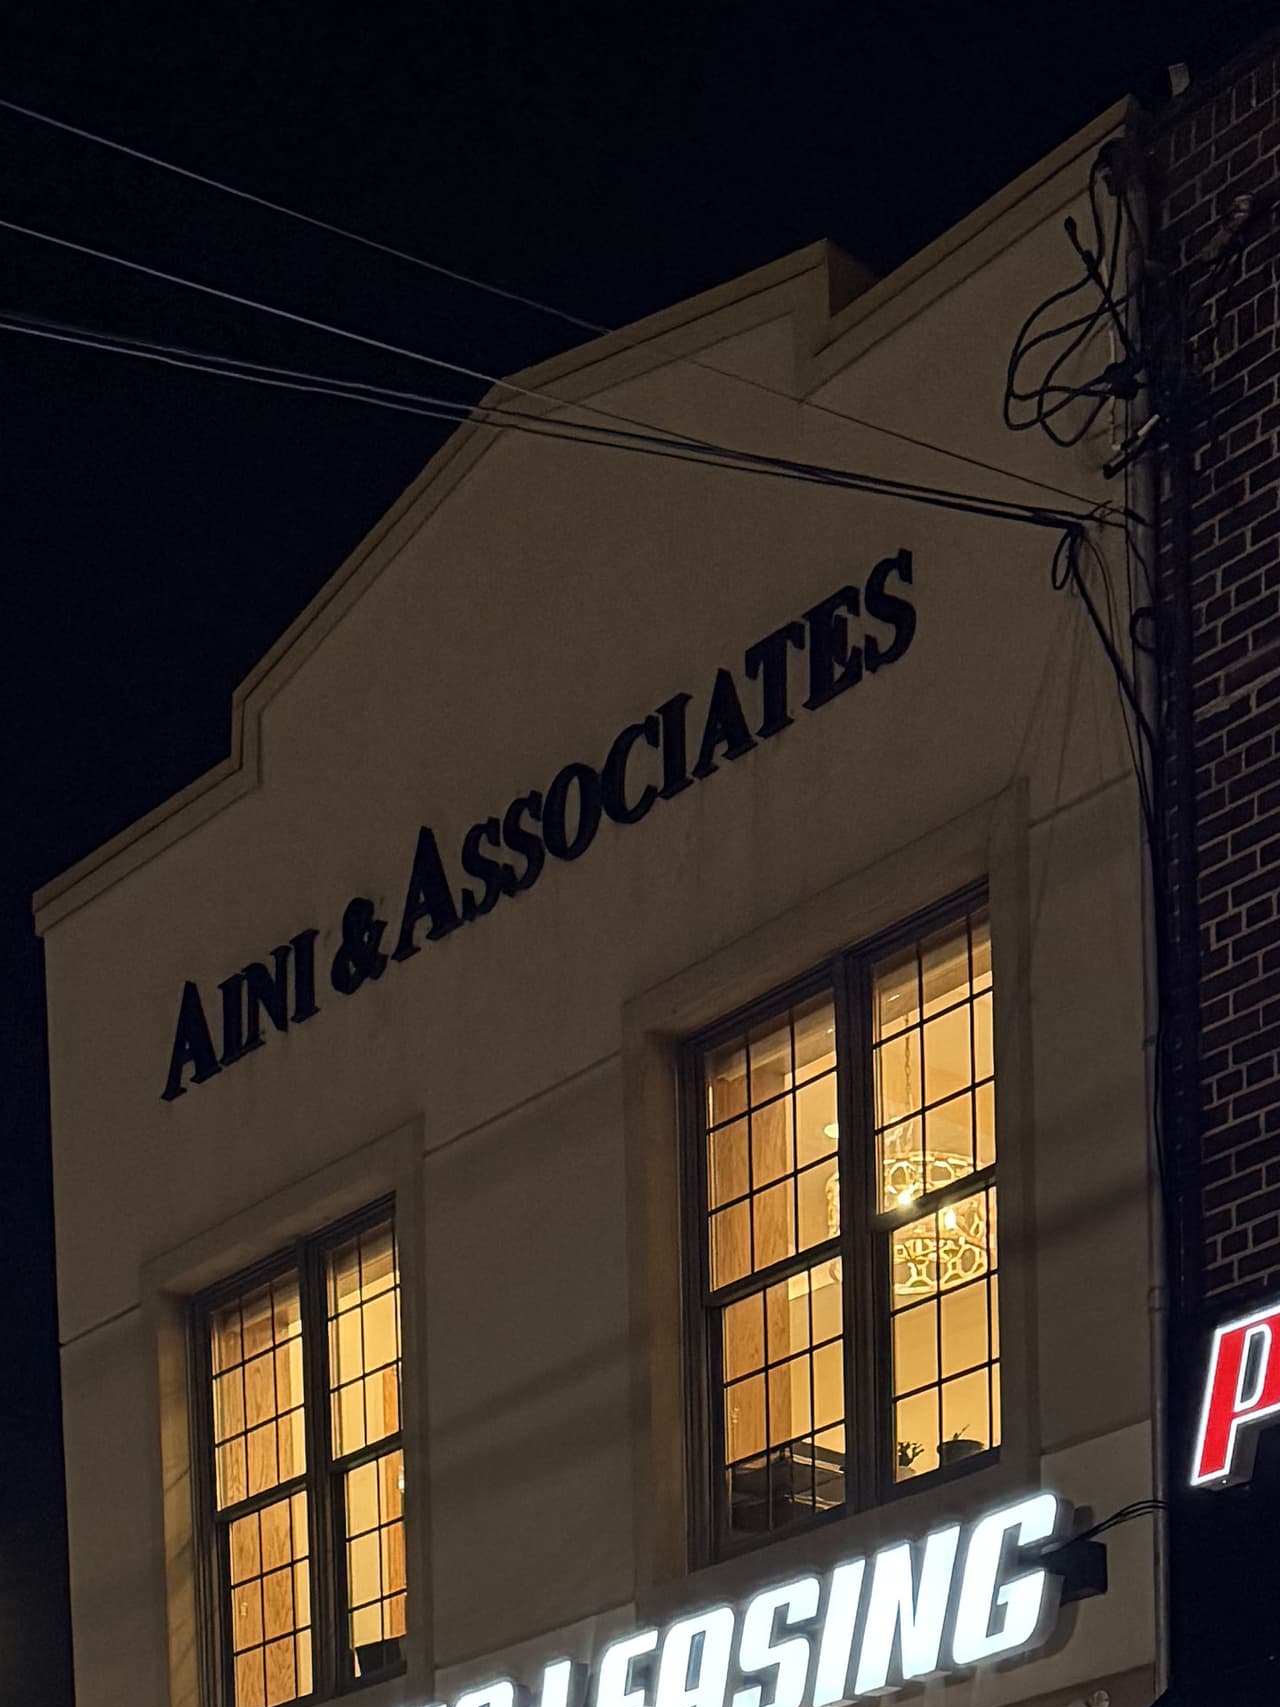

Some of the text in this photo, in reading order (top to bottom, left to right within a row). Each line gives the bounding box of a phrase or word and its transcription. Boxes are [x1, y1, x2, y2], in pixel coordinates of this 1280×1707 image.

[161, 548, 917, 1102] AINI & ASSOCIATES
